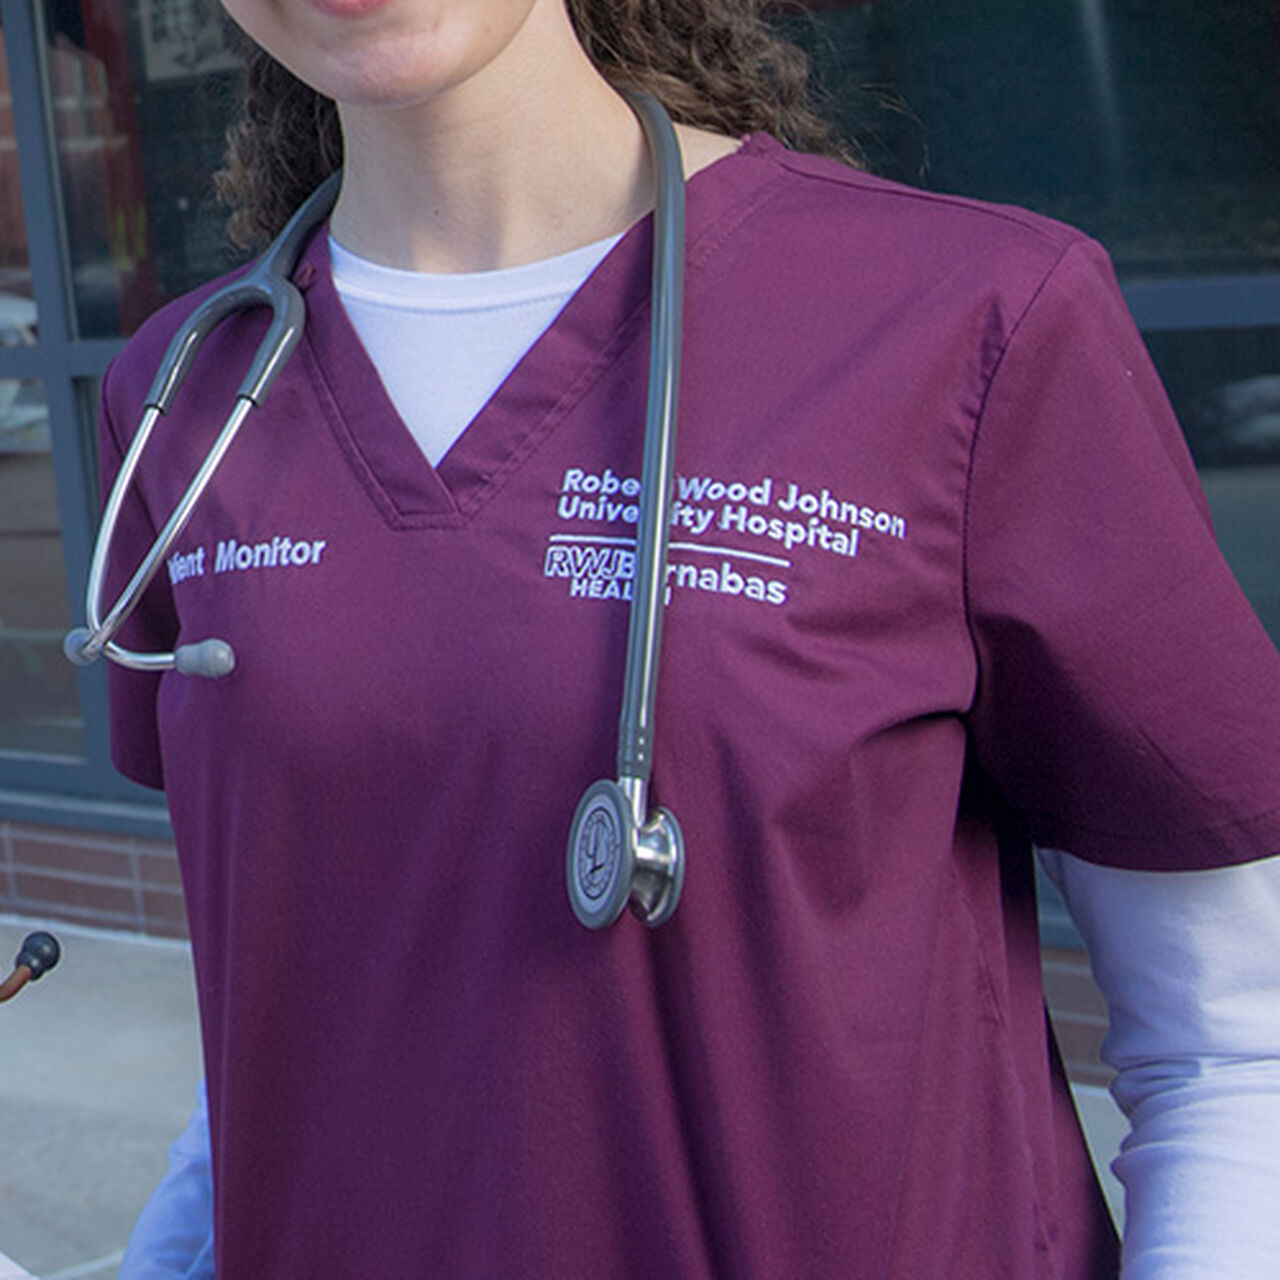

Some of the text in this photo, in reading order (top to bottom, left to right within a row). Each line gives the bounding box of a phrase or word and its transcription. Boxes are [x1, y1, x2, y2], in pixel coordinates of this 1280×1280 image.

[557, 495, 860, 558] Univeity Hospital
[562, 468, 907, 540] Robe Wood Johnson
[214, 535, 327, 574] Monitor
[543, 545, 789, 605] RWJBrnabas
